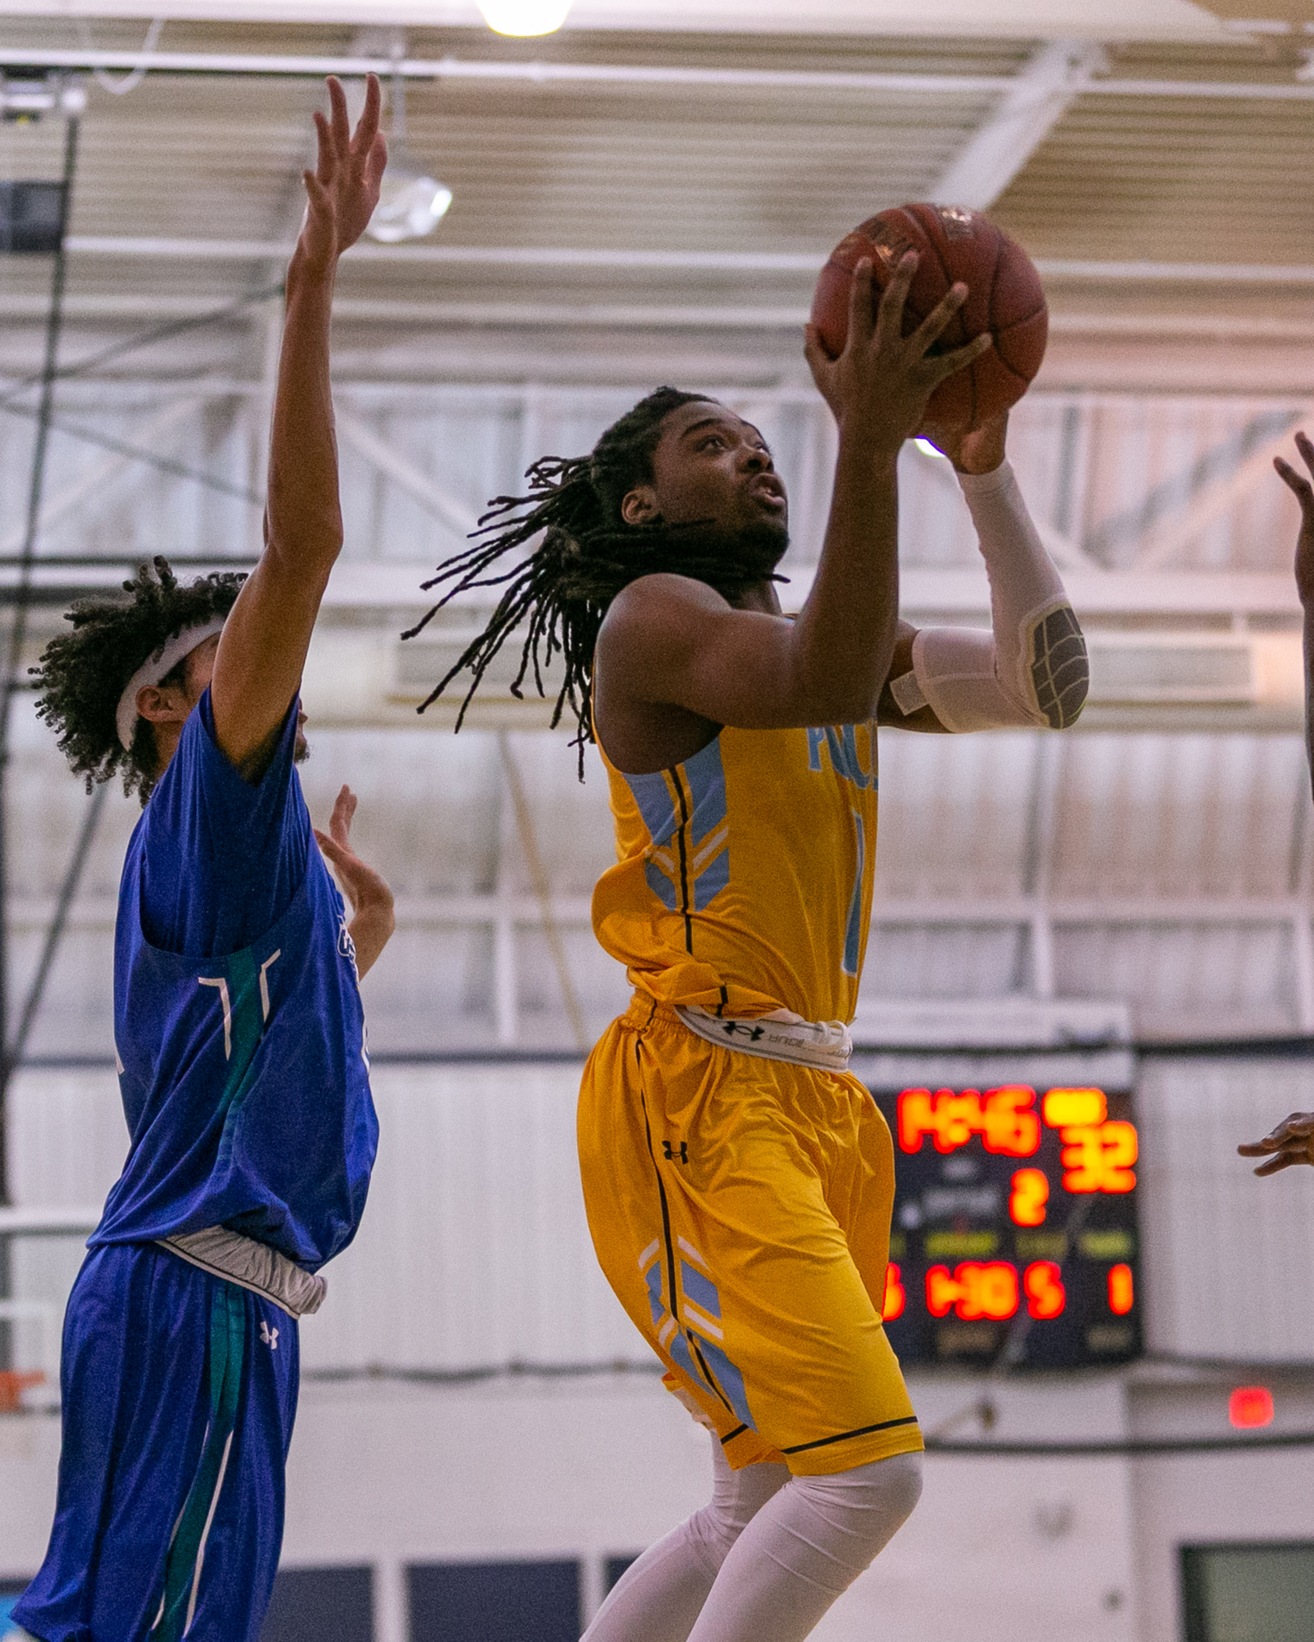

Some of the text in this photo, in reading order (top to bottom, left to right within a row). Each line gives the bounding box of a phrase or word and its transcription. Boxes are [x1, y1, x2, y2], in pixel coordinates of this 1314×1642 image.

[1060, 1121, 1138, 1194] 32
[1009, 1168, 1049, 1227] 2
[1107, 1263, 1133, 1316] 1
